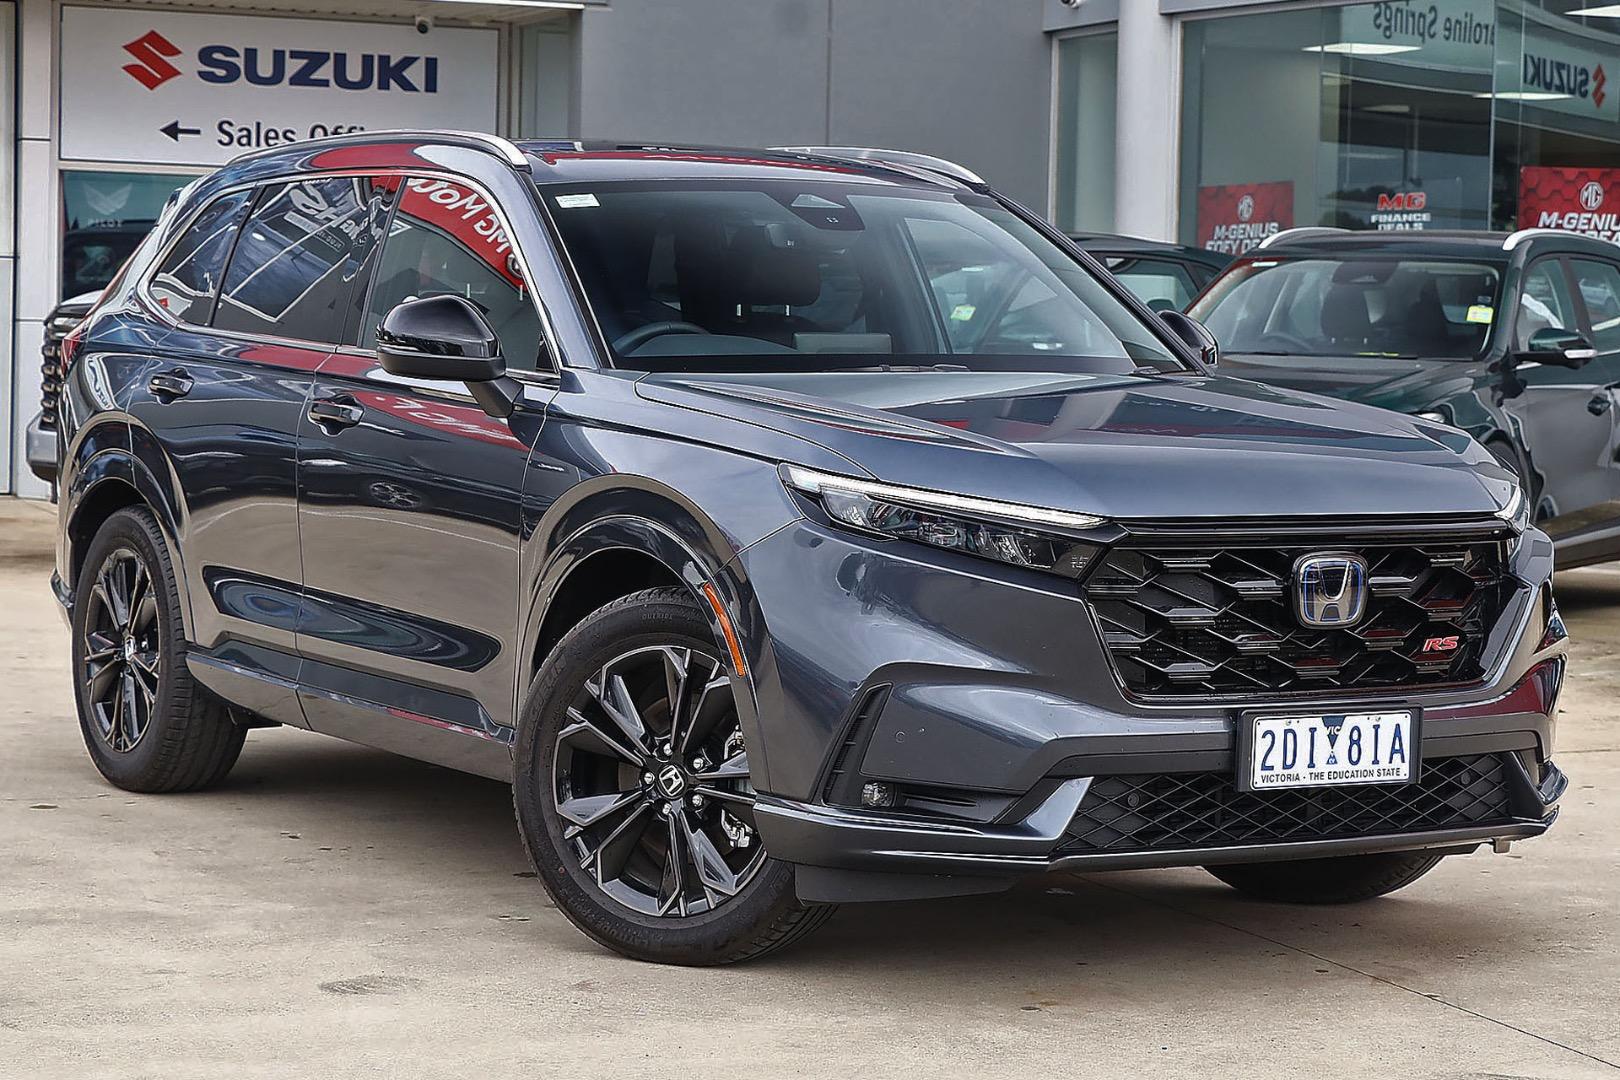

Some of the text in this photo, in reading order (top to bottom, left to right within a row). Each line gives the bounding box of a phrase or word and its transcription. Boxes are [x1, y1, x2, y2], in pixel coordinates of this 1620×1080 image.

[197, 45, 438, 94] SUZUKI
[217, 120, 296, 148] Sales
[1377, 191, 1426, 211] MG
[1371, 212, 1432, 223] FINANCE
[1422, 635, 1460, 652] RS
[1261, 773, 1301, 784] VICTORIA
[1309, 771, 1325, 781] THE
[1327, 769, 1375, 780] EDUCATION
[1377, 767, 1401, 777] STATE
